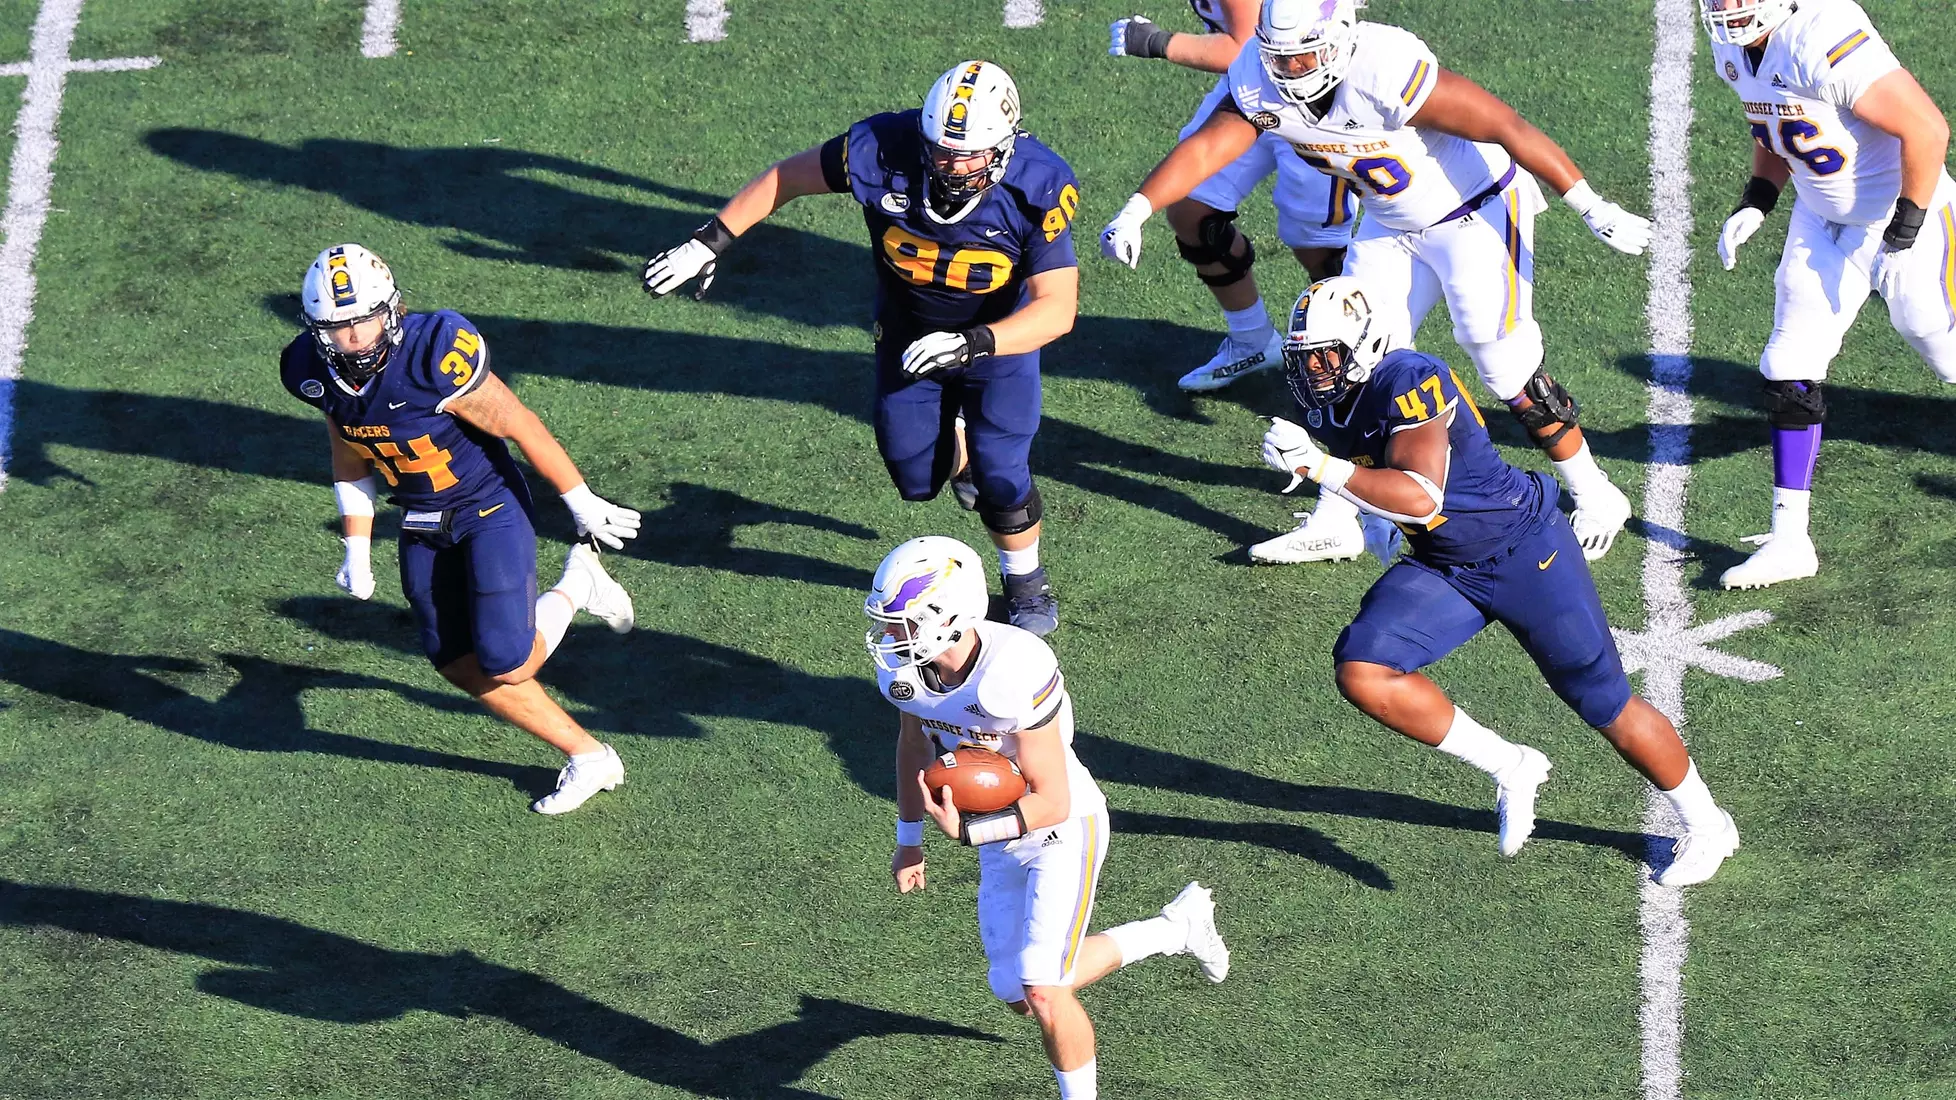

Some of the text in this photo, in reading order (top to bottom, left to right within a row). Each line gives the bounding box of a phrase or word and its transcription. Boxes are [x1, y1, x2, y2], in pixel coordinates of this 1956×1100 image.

[1776, 104, 1805, 116] TECH
[1353, 140, 1390, 153] TECH
[1042, 183, 1080, 243] 90
[882, 225, 1014, 294] 90
[1342, 290, 1372, 321] 47
[440, 327, 481, 388] 34
[1212, 351, 1266, 380] ADIZERO
[1394, 374, 1448, 421] 47
[343, 425, 391, 438] RACERS
[967, 728, 998, 741] TECH
